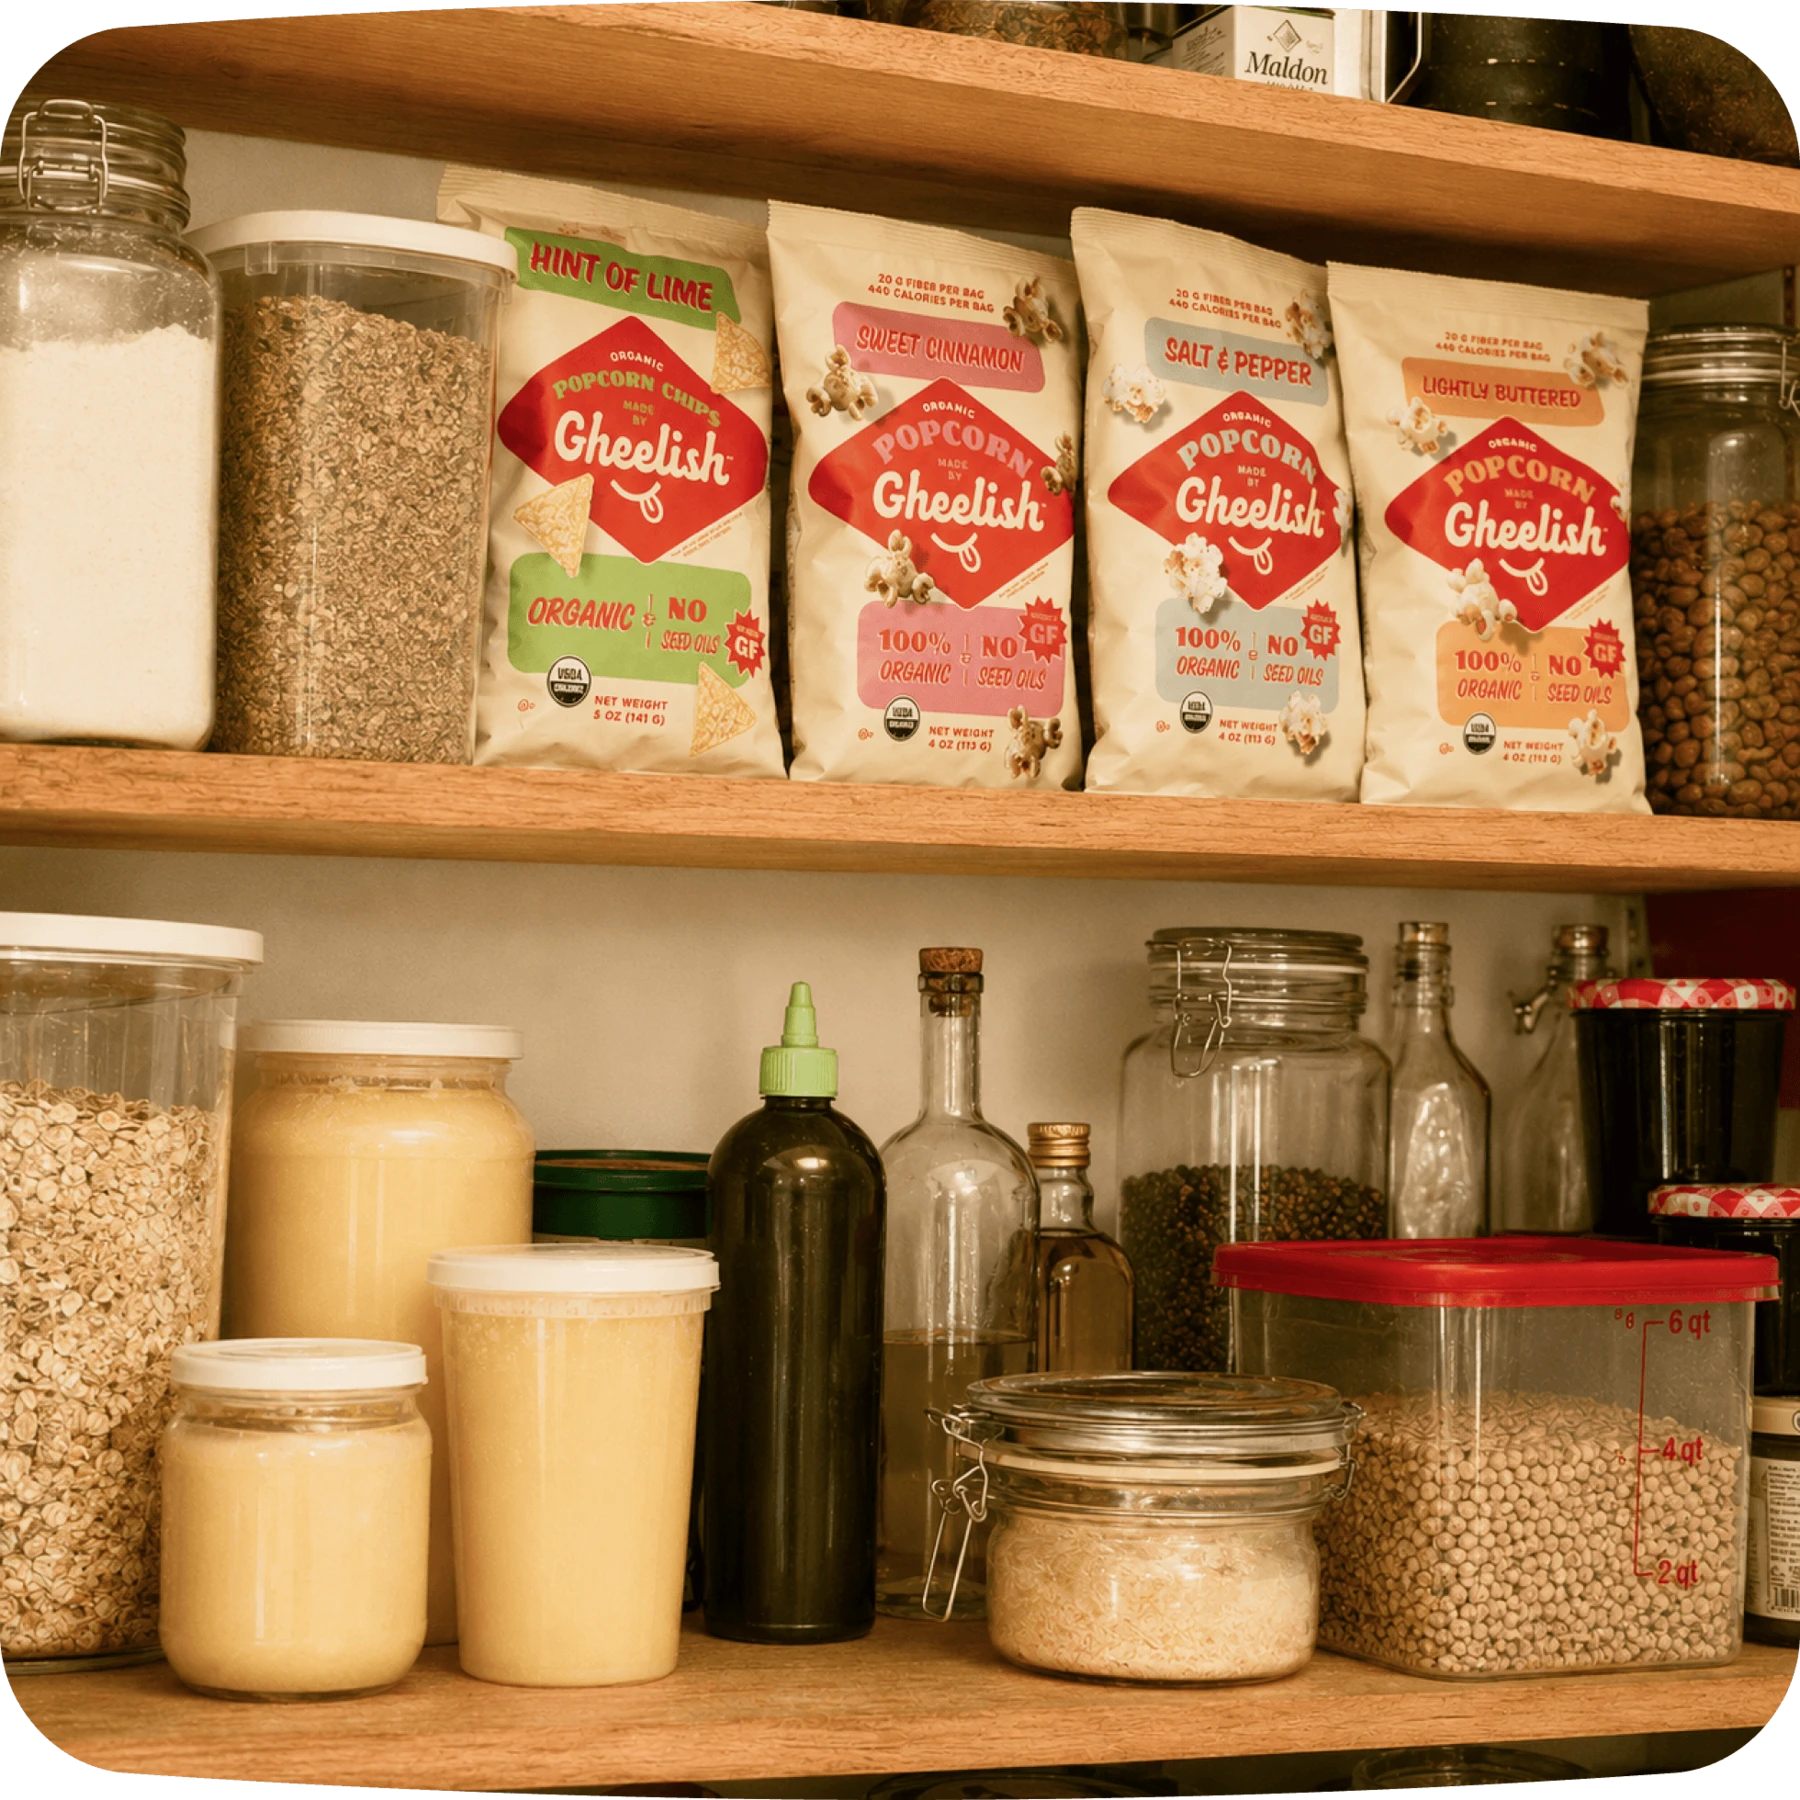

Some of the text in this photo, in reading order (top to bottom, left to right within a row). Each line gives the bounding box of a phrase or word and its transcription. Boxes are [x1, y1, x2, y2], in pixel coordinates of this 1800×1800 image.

[1244, 51, 1328, 85] Maldon
[530, 241, 713, 312] HINT OF LIME
[878, 274, 892, 284] 20
[939, 282, 960, 294] PER
[963, 287, 985, 300] BAG
[868, 284, 994, 314] 440 CALORIES PER BAG
[1176, 288, 1189, 299] 20
[1234, 299, 1252, 312] PER
[1254, 304, 1273, 316] BAG
[1170, 298, 1282, 329] 440 CALORIES PER BAG
[856, 325, 1024, 372] SWEET CINNAMON
[1436, 342, 1550, 362] 440 CALORIES PER BAG
[1445, 332, 1458, 342] 20
[1502, 338, 1520, 348] PER
[1522, 340, 1542, 350] BAG
[610, 351, 664, 372] ORGANIC
[1165, 336, 1312, 386] SALT & PEPPER
[552, 370, 721, 427] POPCORN CHIPS
[1423, 376, 1582, 408] LIGHTLY BUTTERED
[622, 400, 654, 416] MADE
[922, 401, 976, 419] ORGANIC
[632, 415, 647, 426] BY
[1222, 412, 1272, 428] ORGANIC
[554, 409, 729, 486] Gheelish
[872, 419, 1034, 478] POPCORN
[1488, 437, 1537, 452] ORGANIC
[938, 458, 968, 470] MADE
[1176, 429, 1317, 484] POPCORN
[1238, 465, 1267, 477] MADE
[1444, 454, 1596, 504] POPCORN
[872, 468, 1044, 532] Gheelish
[1504, 488, 1534, 500] MADE
[1176, 475, 1324, 538] Gheelish
[1445, 500, 1606, 556] Gheelish
[527, 596, 635, 632] ORGANIC
[668, 597, 707, 623] NO
[660, 630, 721, 655] SEED OILS
[877, 628, 952, 656] 100%
[1029, 623, 1058, 645] GF
[1175, 626, 1241, 652] 100%
[1268, 635, 1298, 656] NO
[1309, 624, 1334, 645] GF
[734, 635, 759, 660] GF
[980, 635, 1018, 659] NO
[1594, 643, 1618, 664] GF
[879, 660, 952, 684] ORGANIC
[1176, 656, 1240, 679] ORGANIC
[1455, 650, 1522, 673] 100%
[1548, 655, 1582, 676] NO
[557, 667, 583, 681] USDA
[978, 666, 1046, 691] SEED OILS
[1264, 664, 1324, 686] SEED OILS
[1457, 678, 1522, 700] ORGANIC
[1547, 683, 1612, 704] SEED OILS
[594, 695, 668, 710] NET WEIGHT
[594, 710, 665, 726] 5 OZ (141 G)
[1220, 719, 1278, 732] NET WEIGHT
[928, 726, 995, 738] NET WEIGHT
[1228, 734, 1241, 742] OZ
[1244, 734, 1262, 744] (113
[1264, 735, 1276, 746] G)
[928, 740, 992, 752] 4 OZ (113 G)
[1503, 741, 1564, 751] NET WEIGHT
[1503, 753, 1562, 765] 4 OZ (113 G)
[1669, 1309, 1711, 1340] 6 qt
[1662, 1436, 1704, 1467] 4 qt
[1658, 1560, 1698, 1590] 2 qt
